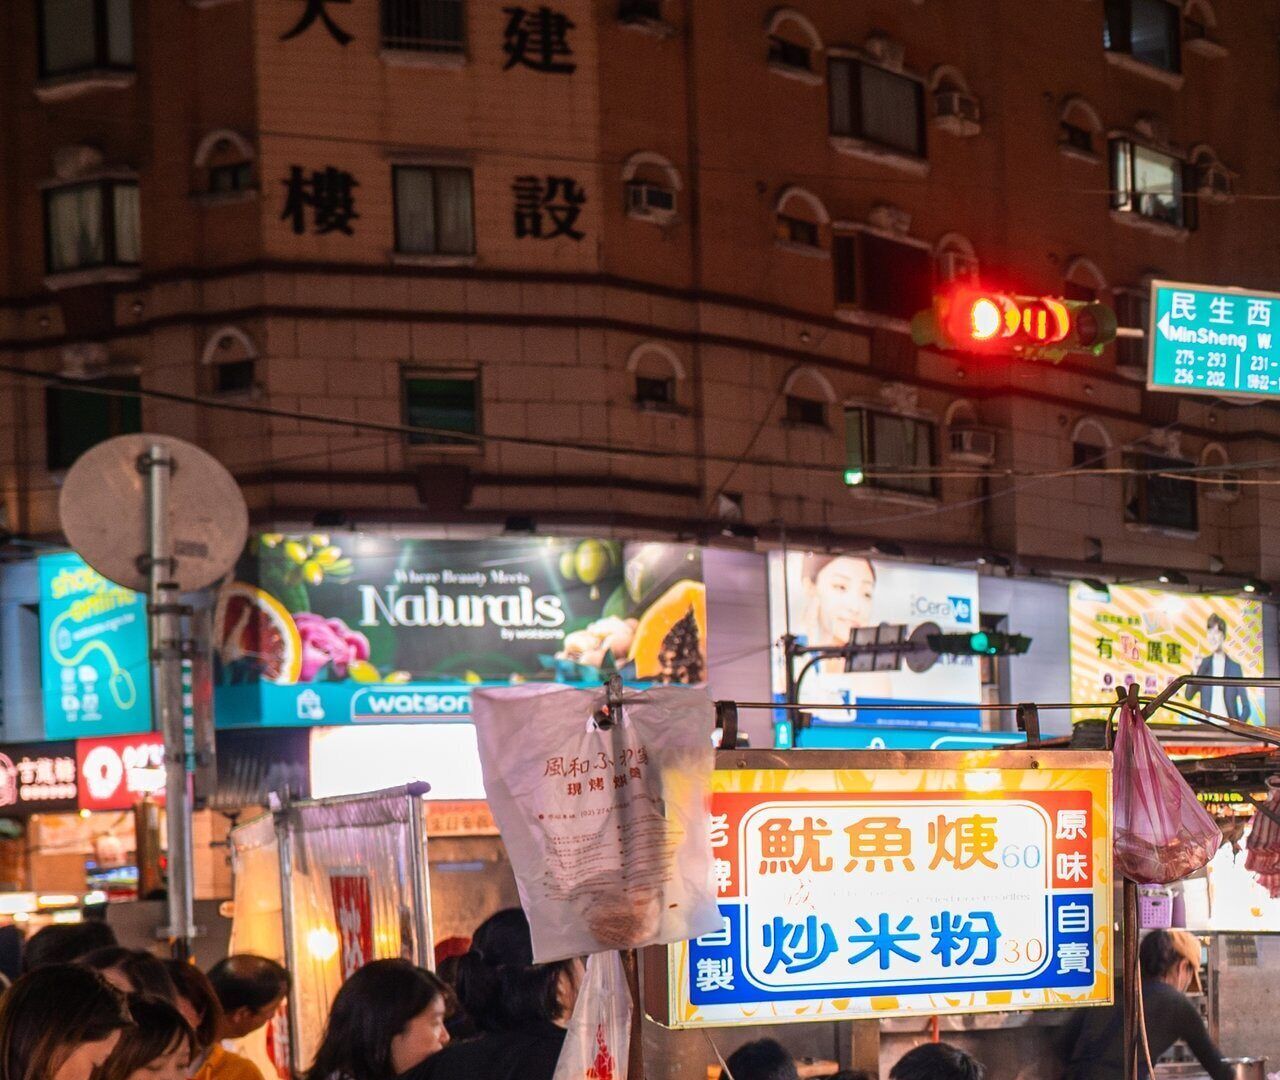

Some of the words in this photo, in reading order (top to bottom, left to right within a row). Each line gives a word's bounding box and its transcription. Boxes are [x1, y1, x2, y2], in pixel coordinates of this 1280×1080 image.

[501, 6, 587, 241] 建設
[1168, 325, 1248, 352] MinSheng
[358, 584, 566, 628] Naturals
[915, 597, 971, 620] CeraVe
[368, 694, 473, 716] watson
[1002, 844, 1042, 869] 60
[1055, 808, 1089, 883] 原味
[761, 909, 1002, 974] 炒米粉
[1003, 938, 1043, 964] 30
[1056, 902, 1091, 976] 自賣
